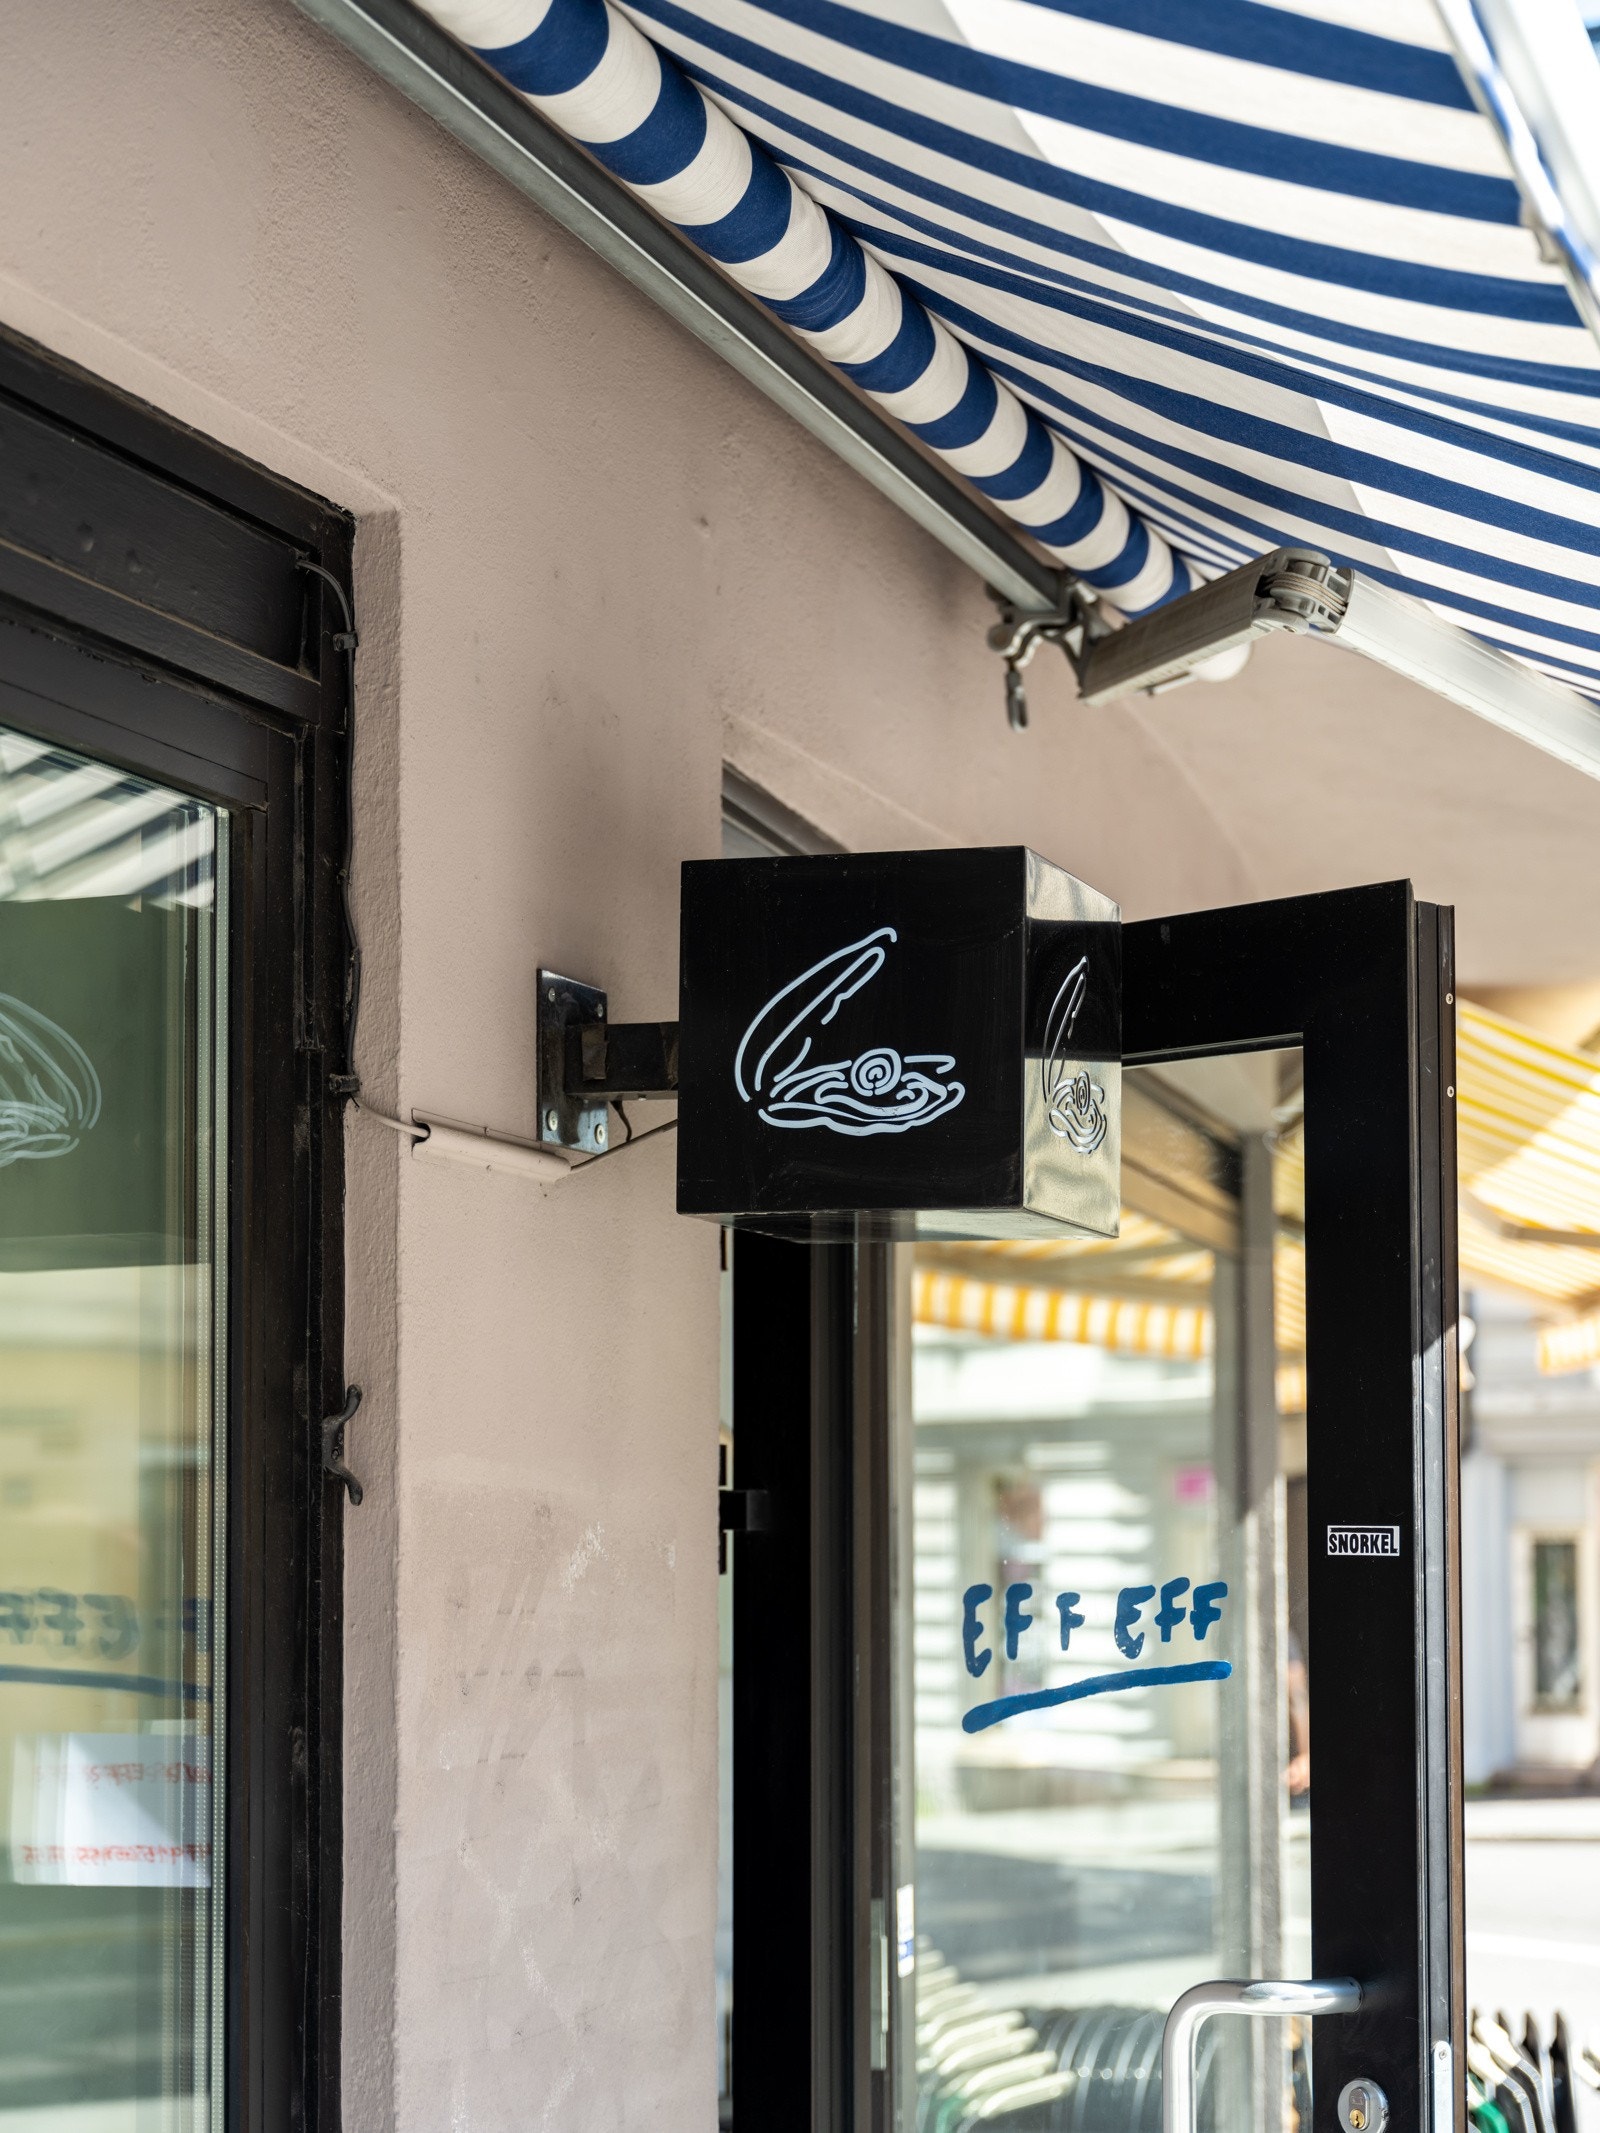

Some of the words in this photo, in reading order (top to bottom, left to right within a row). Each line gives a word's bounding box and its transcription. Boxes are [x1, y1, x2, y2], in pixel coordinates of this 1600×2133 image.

[1329, 1528, 1398, 1554] SNORKEL
[963, 1583, 1085, 1677] EFF
[1114, 1577, 1228, 1659] EFF
